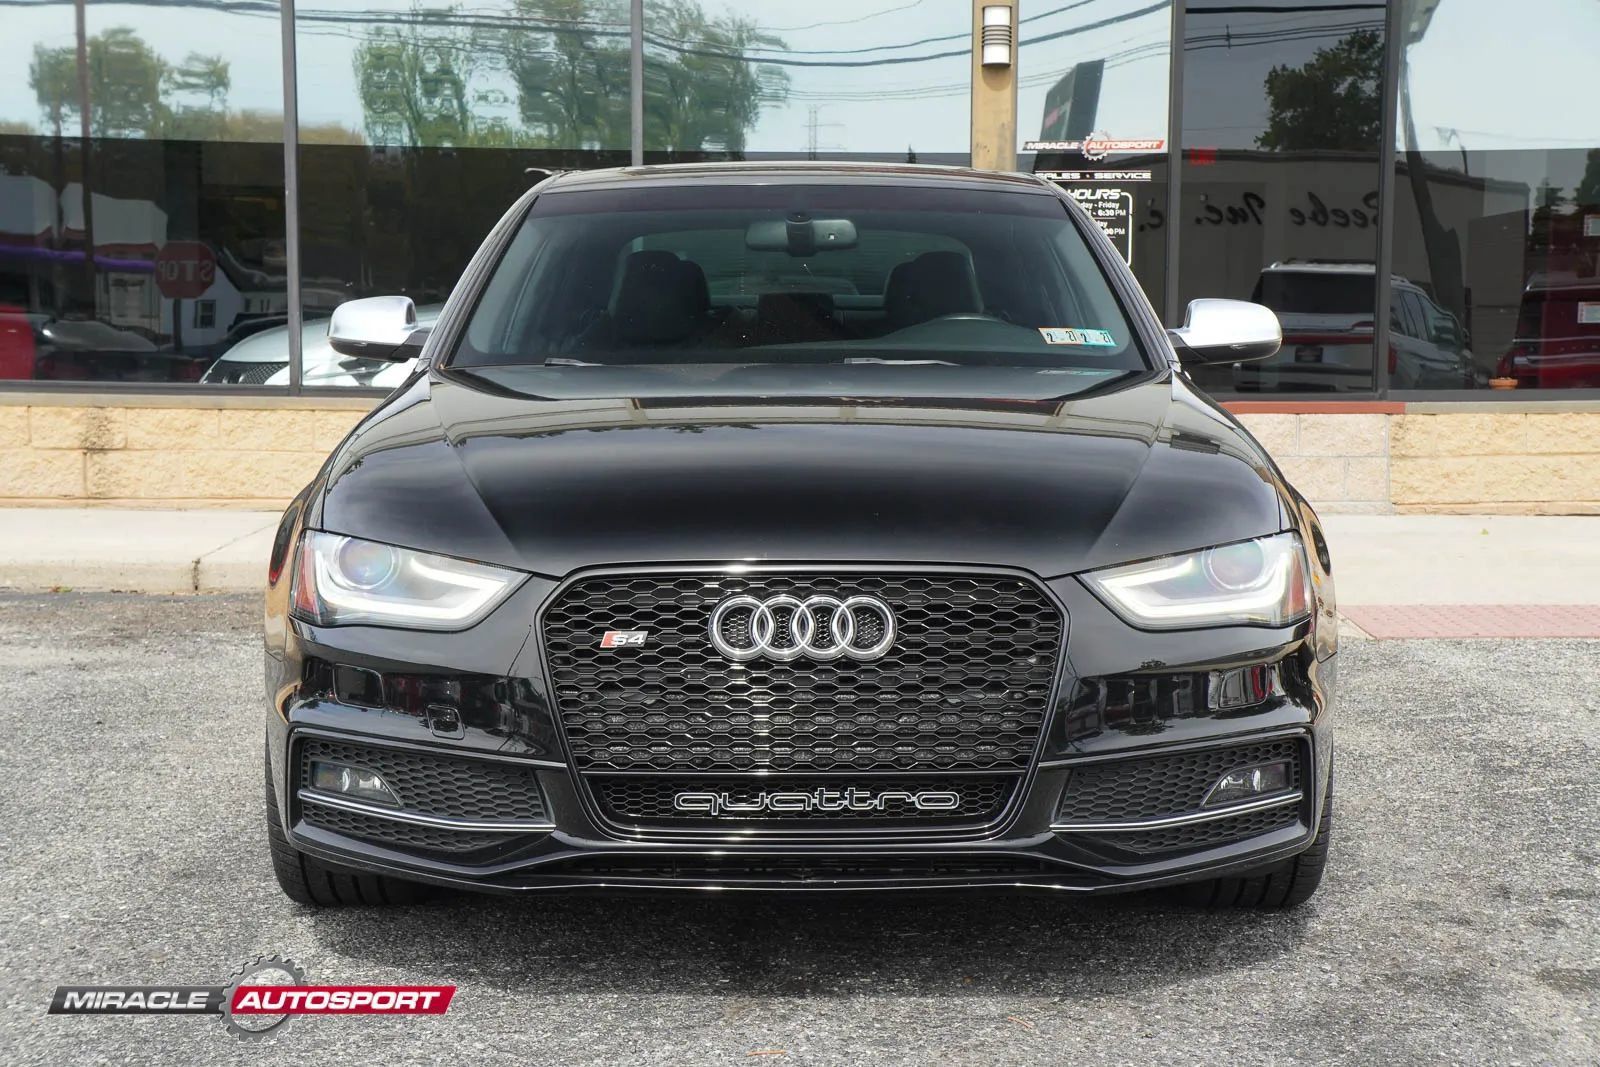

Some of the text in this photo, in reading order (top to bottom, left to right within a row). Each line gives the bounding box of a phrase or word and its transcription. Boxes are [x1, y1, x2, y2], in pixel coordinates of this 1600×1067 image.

[1026, 140, 1161, 150] MIRACLE AUTOSPORT
[1036, 172, 1152, 180] SALES SERVICE
[1067, 188, 1121, 200] HOURS
[1098, 201, 1120, 210] Friday
[1097, 209, 1115, 217] 6:30
[1115, 209, 1127, 217] PM
[1114, 227, 1126, 235] PM
[610, 632, 646, 646] S4
[674, 787, 960, 816] quattro
